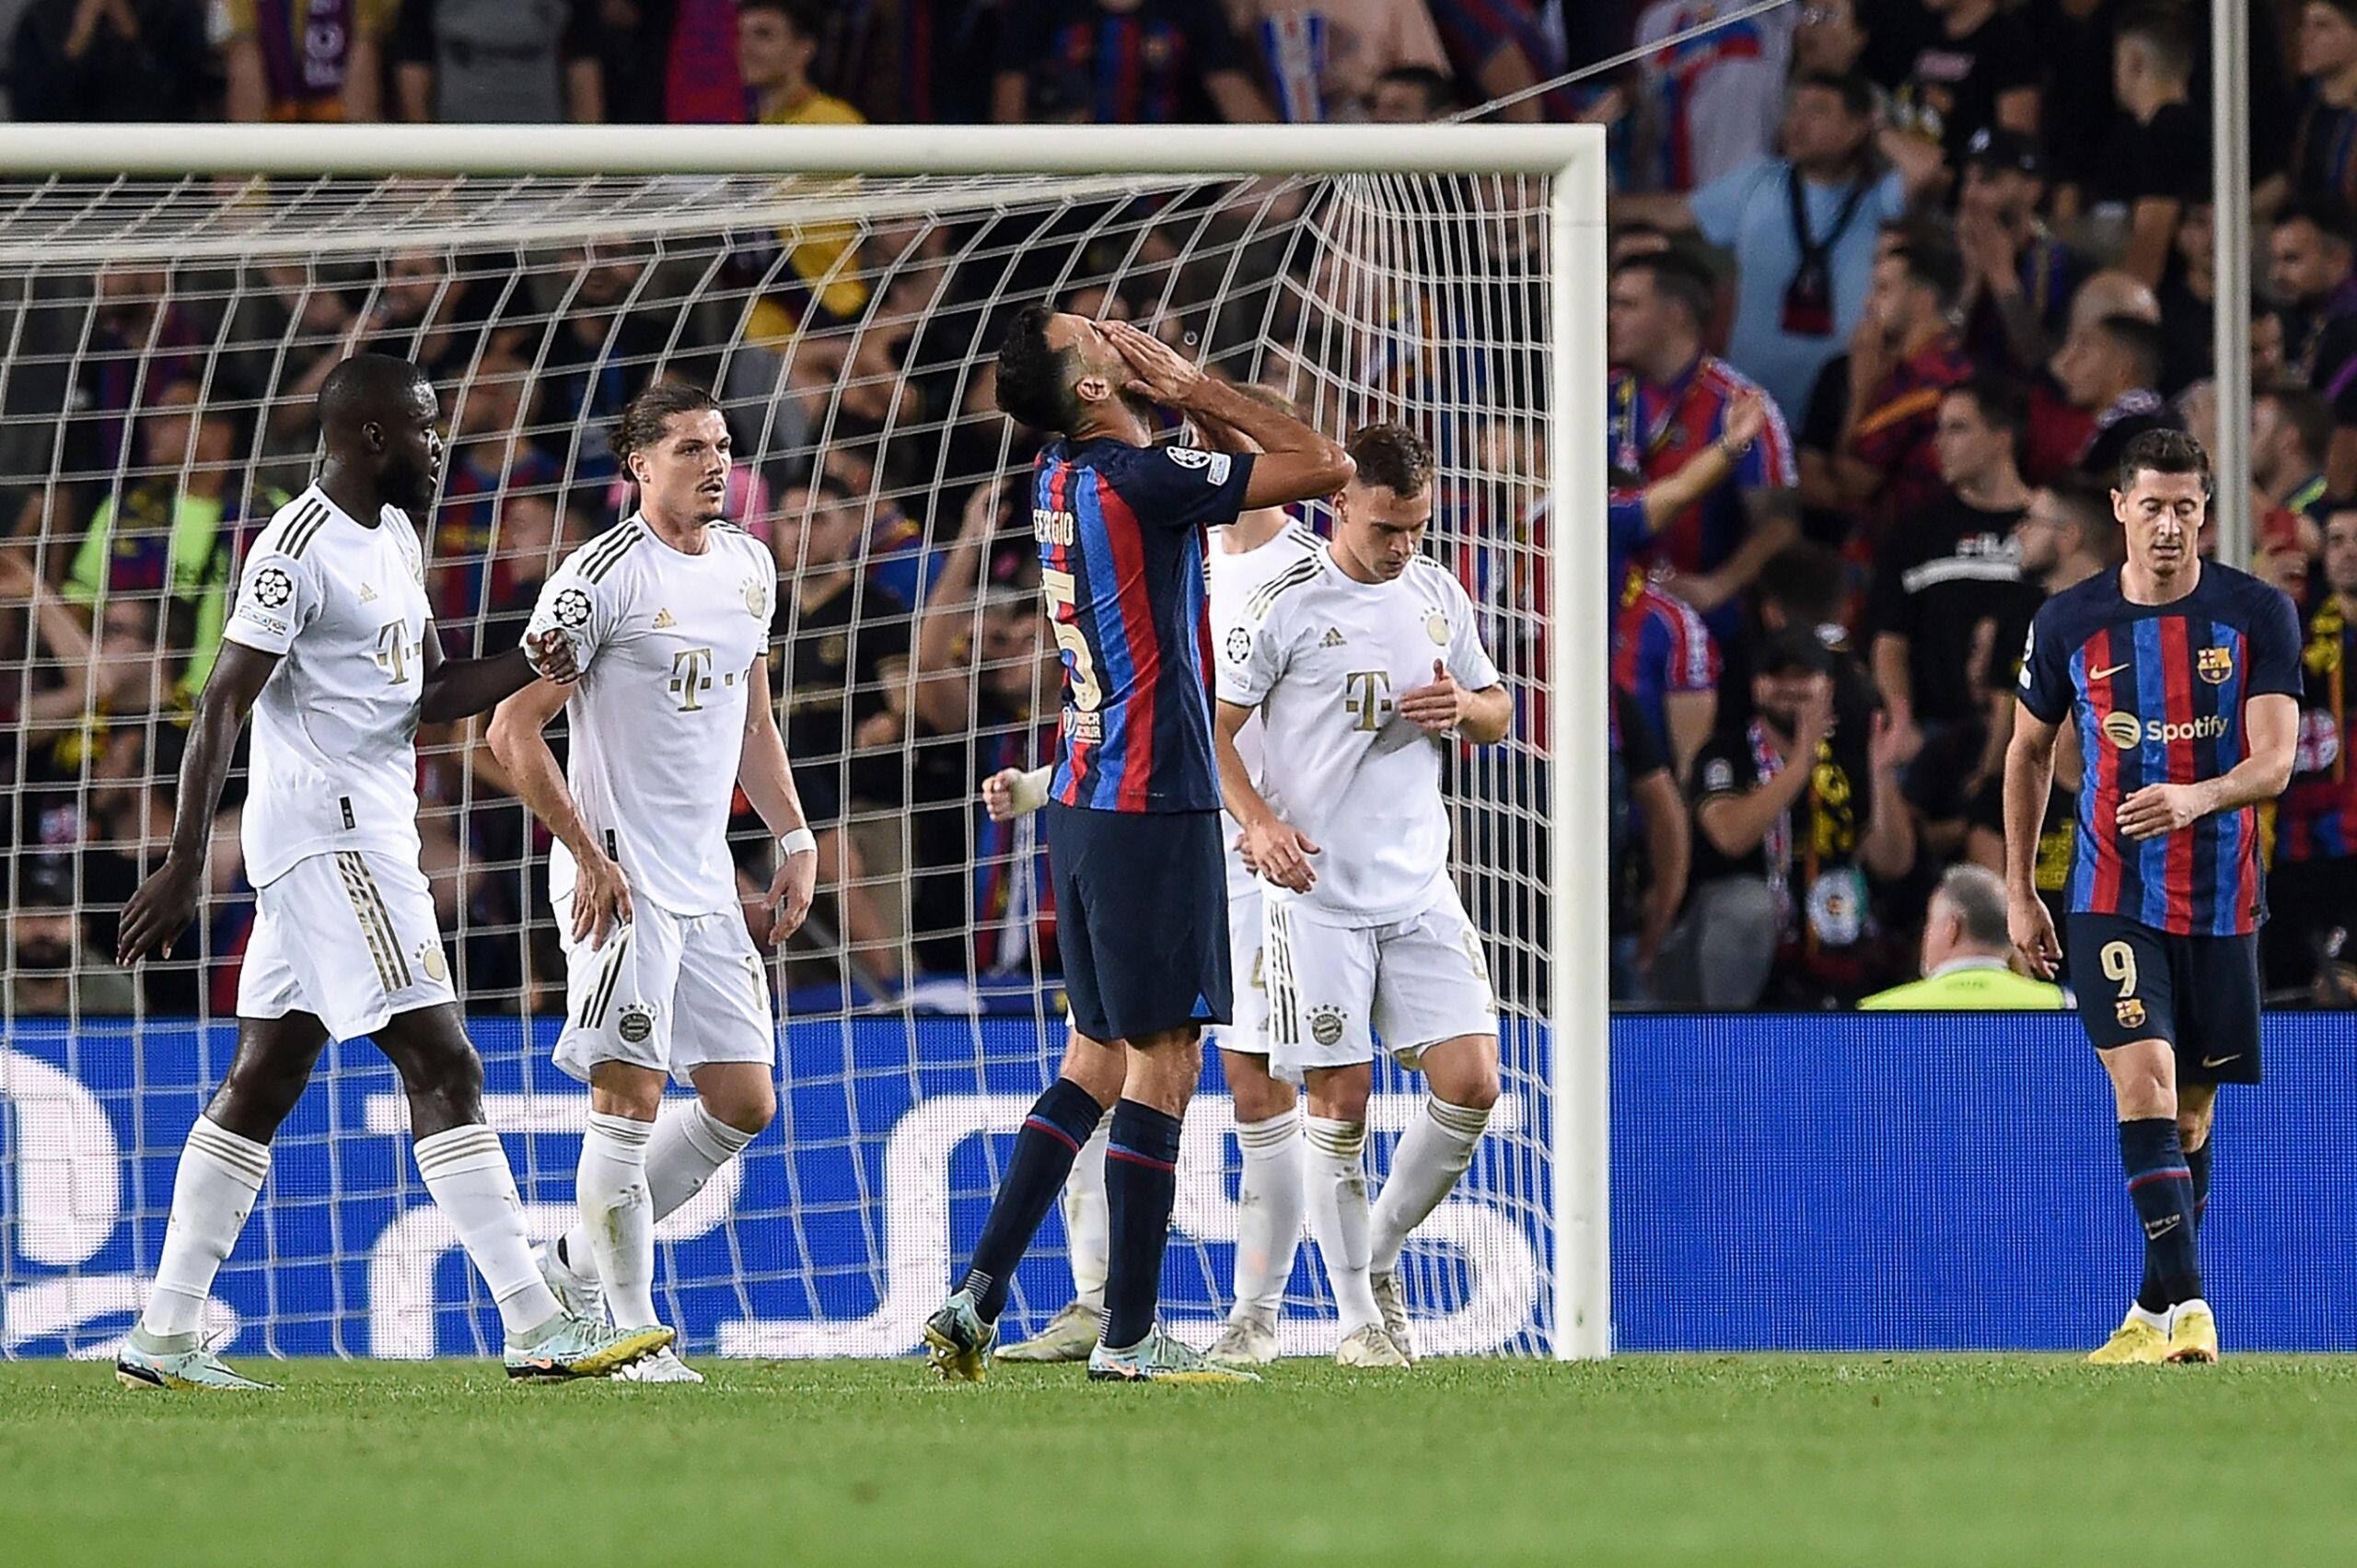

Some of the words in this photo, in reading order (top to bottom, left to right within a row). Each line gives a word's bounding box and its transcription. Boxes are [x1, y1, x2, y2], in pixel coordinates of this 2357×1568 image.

[1042, 568, 1102, 712] 5
[2146, 714, 2228, 744] Spotify
[2100, 941, 2137, 997] 9
